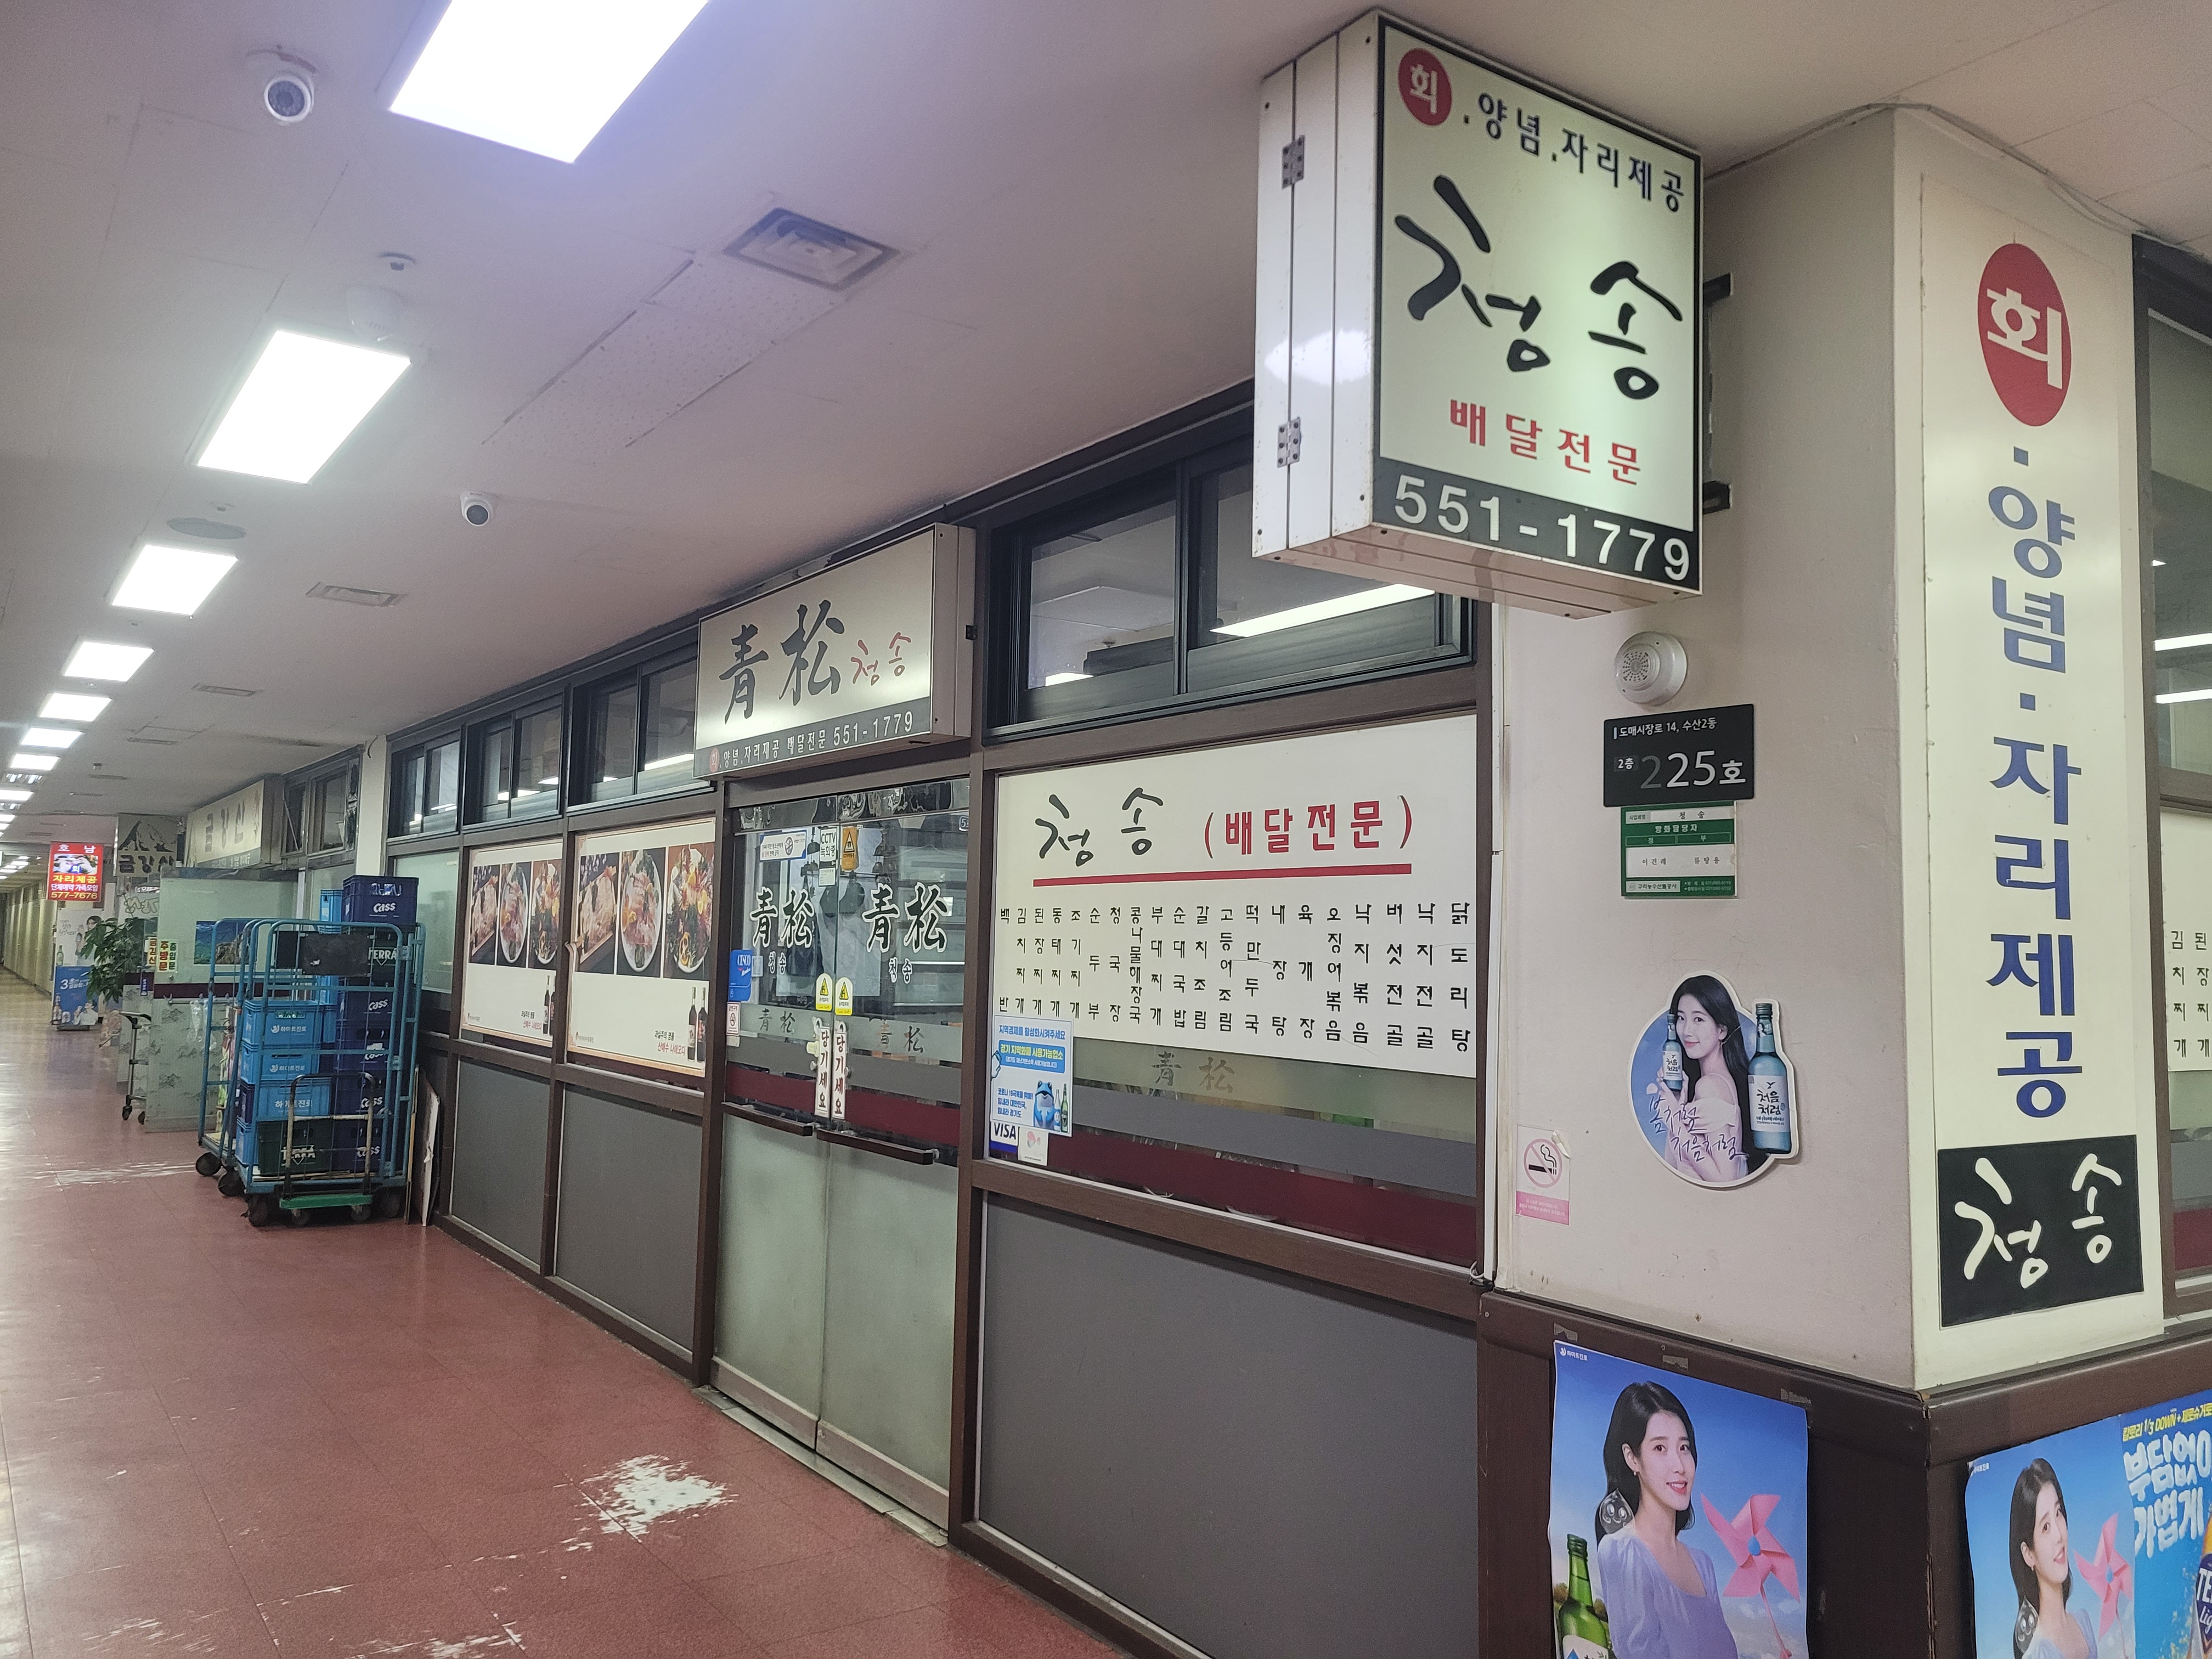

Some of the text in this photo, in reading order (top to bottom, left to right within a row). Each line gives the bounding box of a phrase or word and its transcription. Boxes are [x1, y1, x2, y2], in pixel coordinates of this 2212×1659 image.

[1410, 64, 1438, 115] 회
[1986, 287, 2063, 390] 회
[1450, 399, 1641, 485] 배달전문
[1394, 474, 1690, 581] 551-1779
[719, 600, 845, 724] 青松
[787, 729, 827, 755] 배달전문
[833, 711, 913, 747] 551-1779
[1618, 717, 1717, 738] 도매시장로 14, 수산2동
[1618, 758, 1634, 770] 2층
[58, 844, 97, 854] 호남
[821, 832, 836, 844] CCTV
[821, 845, 836, 857] 녹화중
[1204, 795, 1413, 859] (배달전문)
[1655, 823, 1698, 833] 방화담당자
[52, 874, 97, 884] 자리제공
[75, 884, 98, 892] 가족모임
[750, 887, 814, 948] 青松
[862, 882, 947, 953] 青松
[368, 950, 396, 960] TERRA
[1000, 908, 1009, 1012] 백반
[1015, 908, 1026, 1014] 김치찌개
[1032, 908, 1045, 1016] 된장찌개
[1050, 907, 1062, 1017] 동태찌개
[1070, 910, 1081, 1019] 조기찌개
[1088, 907, 1101, 1020] 순두부
[1109, 907, 1121, 1022] 청국장
[1130, 907, 1143, 1024] 콩나물해장국
[1150, 906, 1163, 1026] 부대찌개
[1173, 906, 1186, 1028] 순대국밥
[1194, 906, 1209, 1029] 갈치조림
[1219, 909, 1233, 1032] 고등어조림
[1245, 905, 1261, 1034] 떡만두국
[1272, 905, 1287, 1036] 내장탕
[1298, 905, 1315, 1039] 육개장
[1325, 907, 1341, 1041] 오징어볶음
[1352, 904, 1372, 1043] 낙지볶음
[1386, 904, 1403, 1046] 버섯전골
[1417, 903, 1435, 1049] 낙지전골
[1451, 902, 1470, 1052] 닭도리탕
[2171, 930, 2186, 1058] 김치찌개
[2195, 932, 2209, 1058] 된장찌개
[819, 1030, 830, 1108] 당기세요
[834, 1035, 845, 1114] 당기세요
[1151, 1051, 1235, 1094] 青松
[1757, 1089, 1780, 1103] 처음
[1758, 1103, 1782, 1116] 처럼
[994, 1122, 1017, 1140] VISA
[1567, 1350, 1588, 1361] 하이트진로
[2123, 1423, 2143, 1442] 칼로리
[2155, 1413, 2177, 1432] DOWN
[2134, 1487, 2204, 1558] 가볍게
